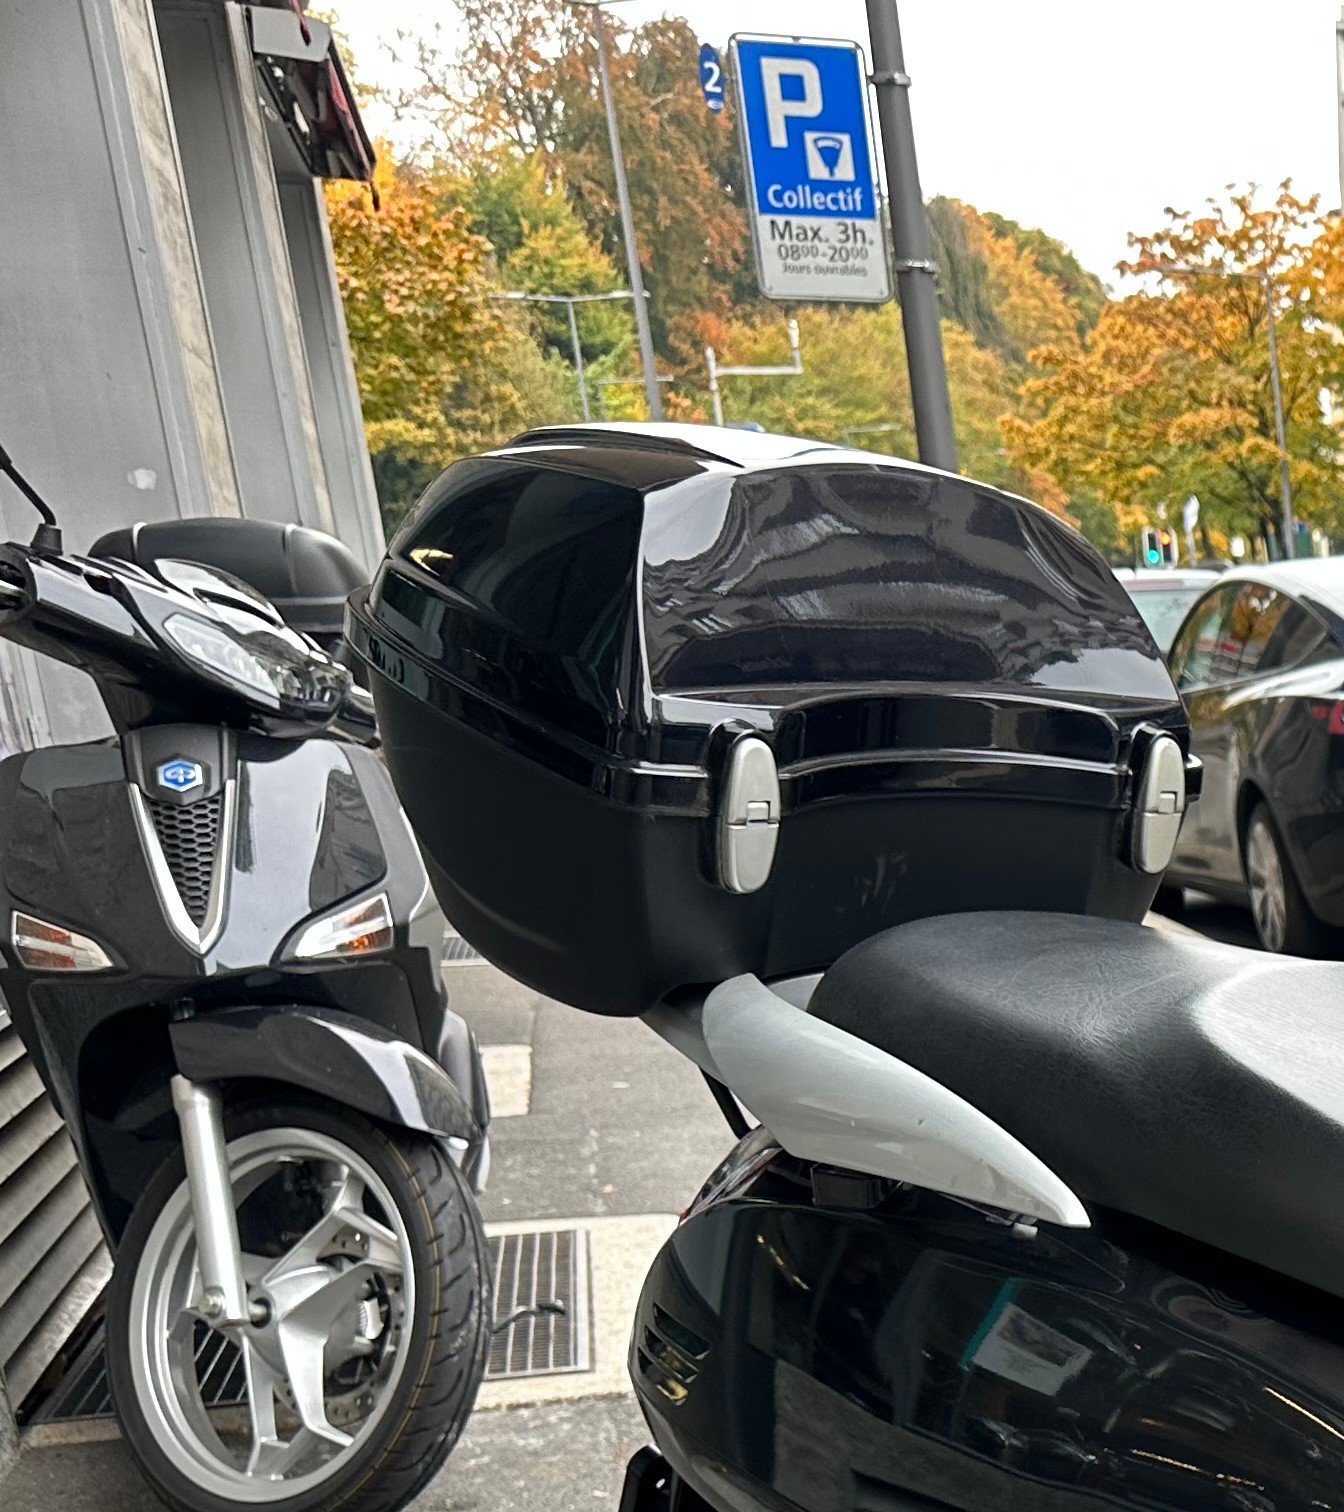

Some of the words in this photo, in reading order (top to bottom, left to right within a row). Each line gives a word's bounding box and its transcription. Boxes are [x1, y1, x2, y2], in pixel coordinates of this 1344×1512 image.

[702, 60, 722, 94] 2
[759, 56, 823, 148] P
[767, 183, 864, 212] Collectif
[770, 219, 830, 243] Max.
[837, 221, 874, 246] 3h.
